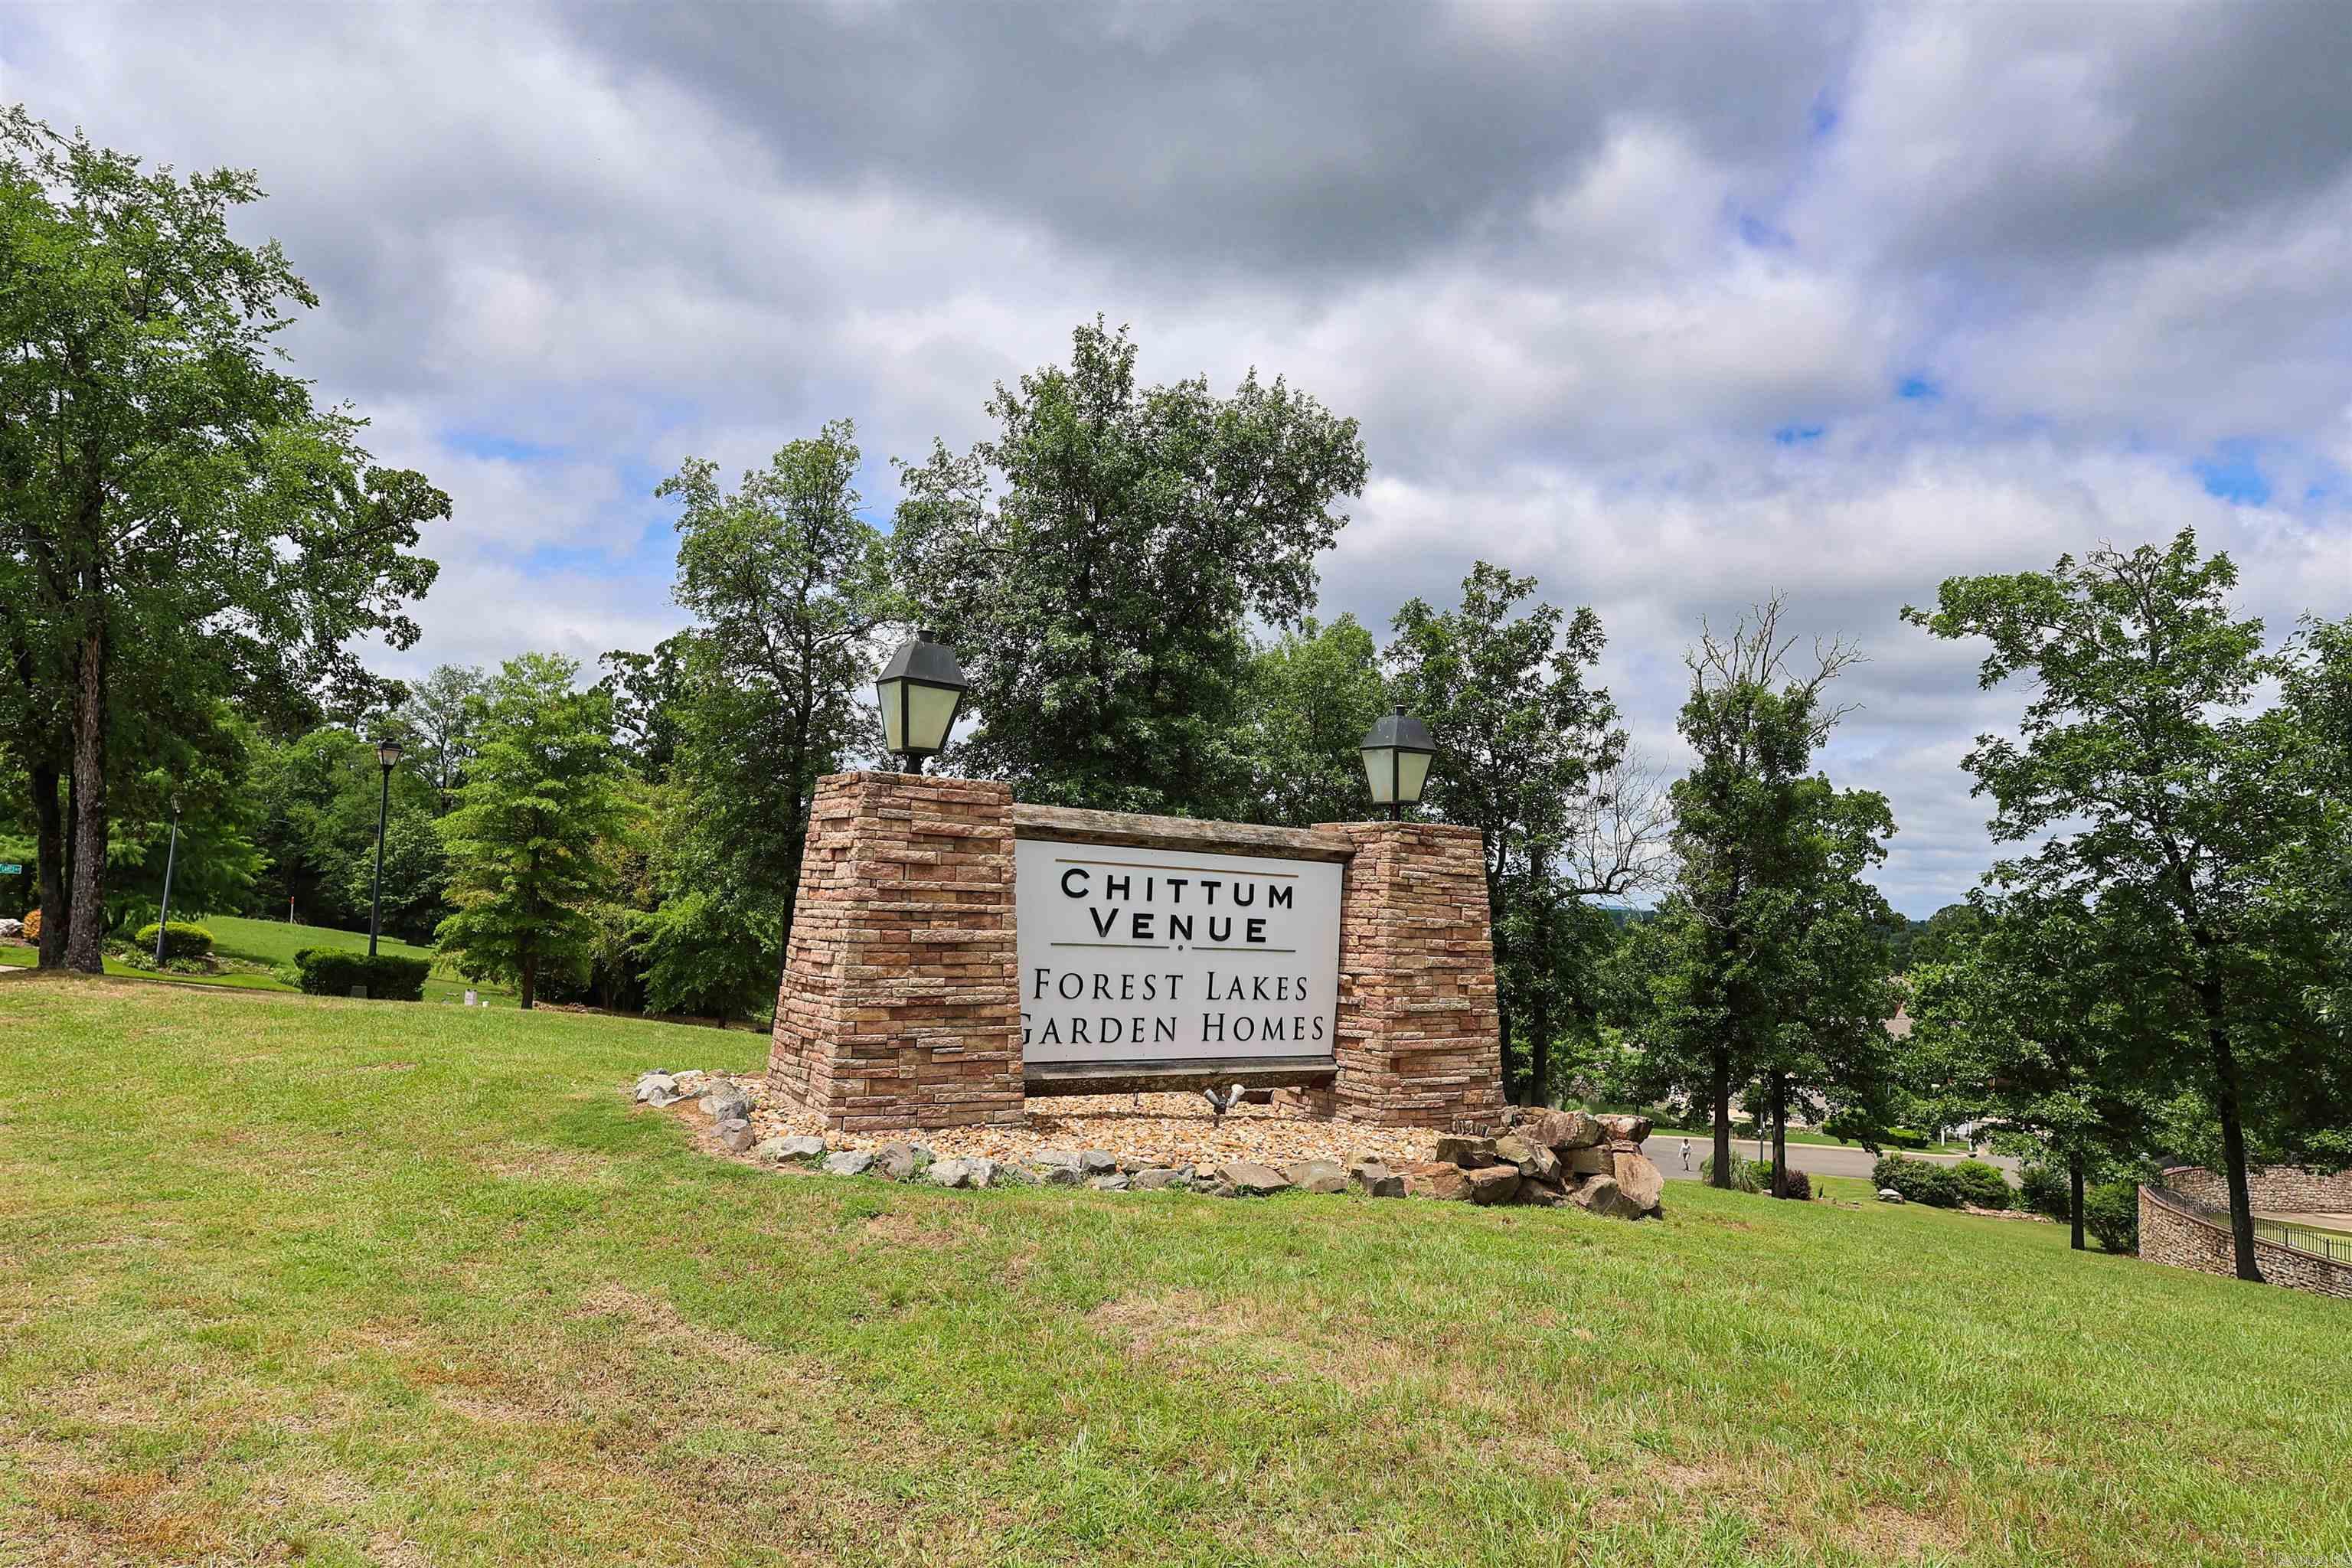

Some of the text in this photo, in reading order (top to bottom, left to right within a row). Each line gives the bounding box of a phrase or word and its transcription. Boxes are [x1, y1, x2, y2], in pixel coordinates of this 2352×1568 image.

[1061, 868, 1293, 909] CHITTUM
[1089, 907, 1267, 942] VENUE
[1033, 969, 1308, 1001] FOREST LAKES
[1202, 1013, 1324, 1042] HOMES
